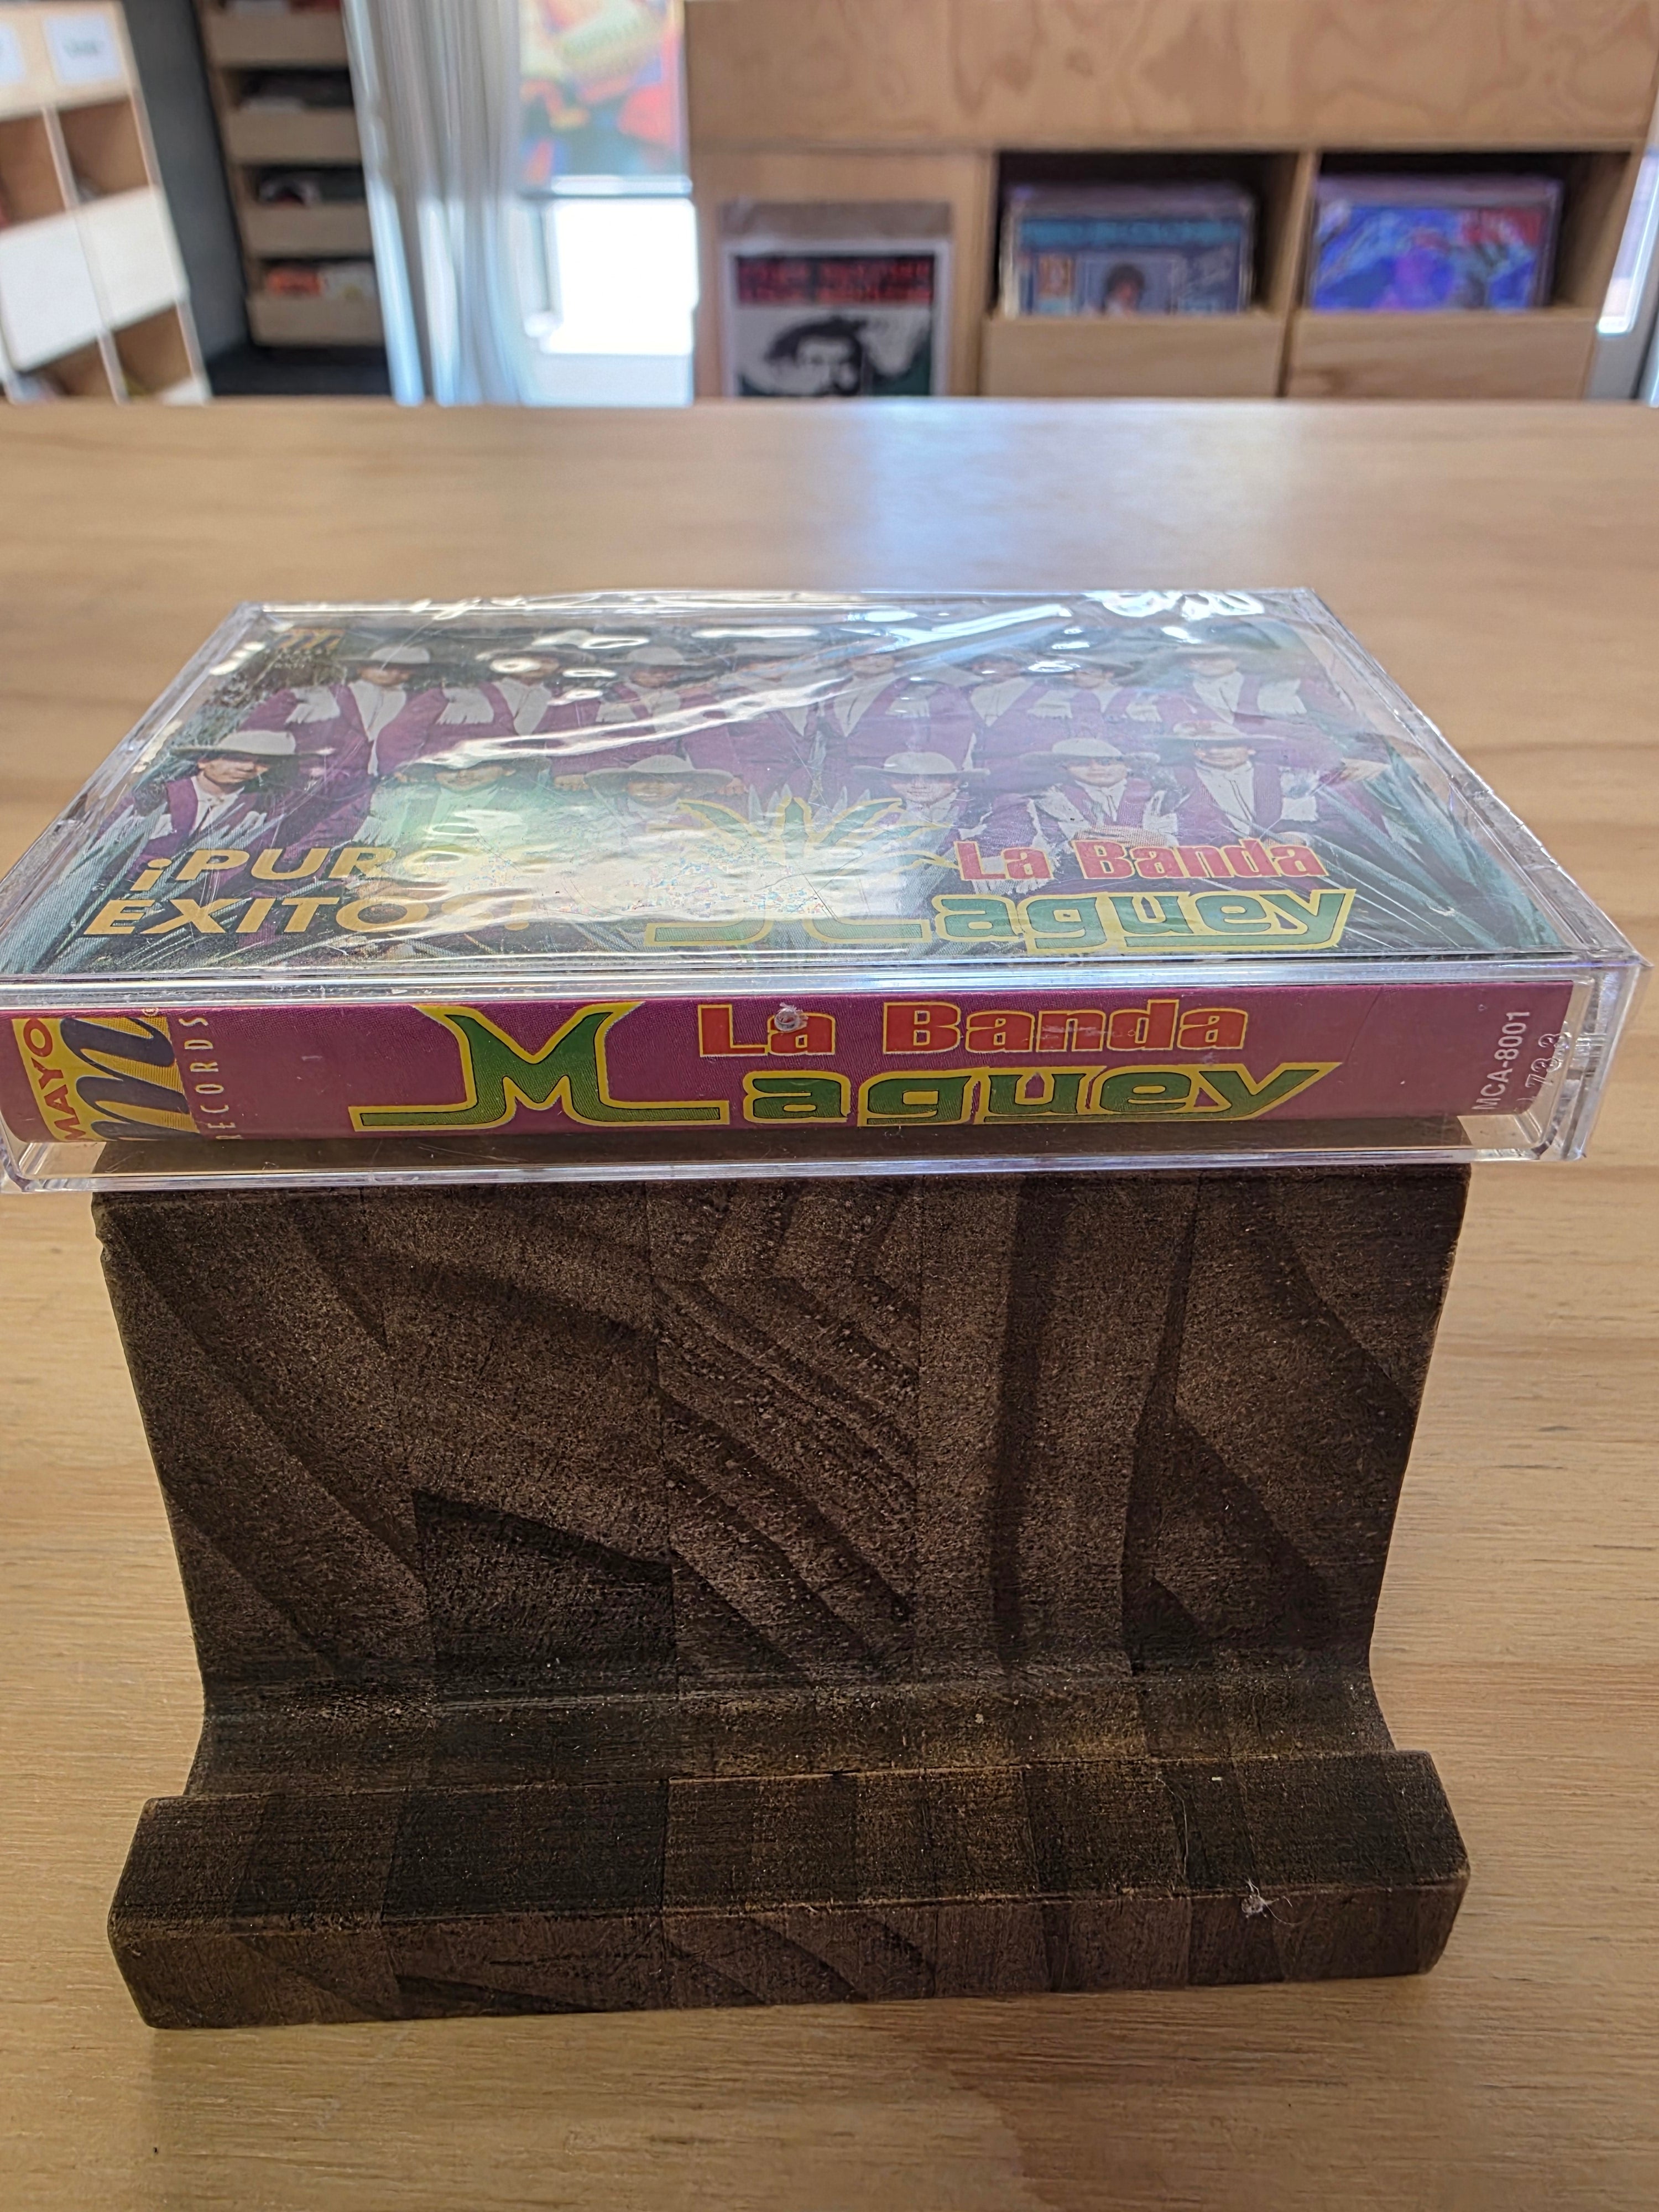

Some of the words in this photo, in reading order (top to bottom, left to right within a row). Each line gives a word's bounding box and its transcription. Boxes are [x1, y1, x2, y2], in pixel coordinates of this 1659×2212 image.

[953, 841, 1054, 881] La
[1071, 838, 1330, 879] Banda
[698, 1004, 836, 1057] La
[884, 999, 1248, 1055] Banda
[1471, 1011, 1531, 1110] MCA-8001
